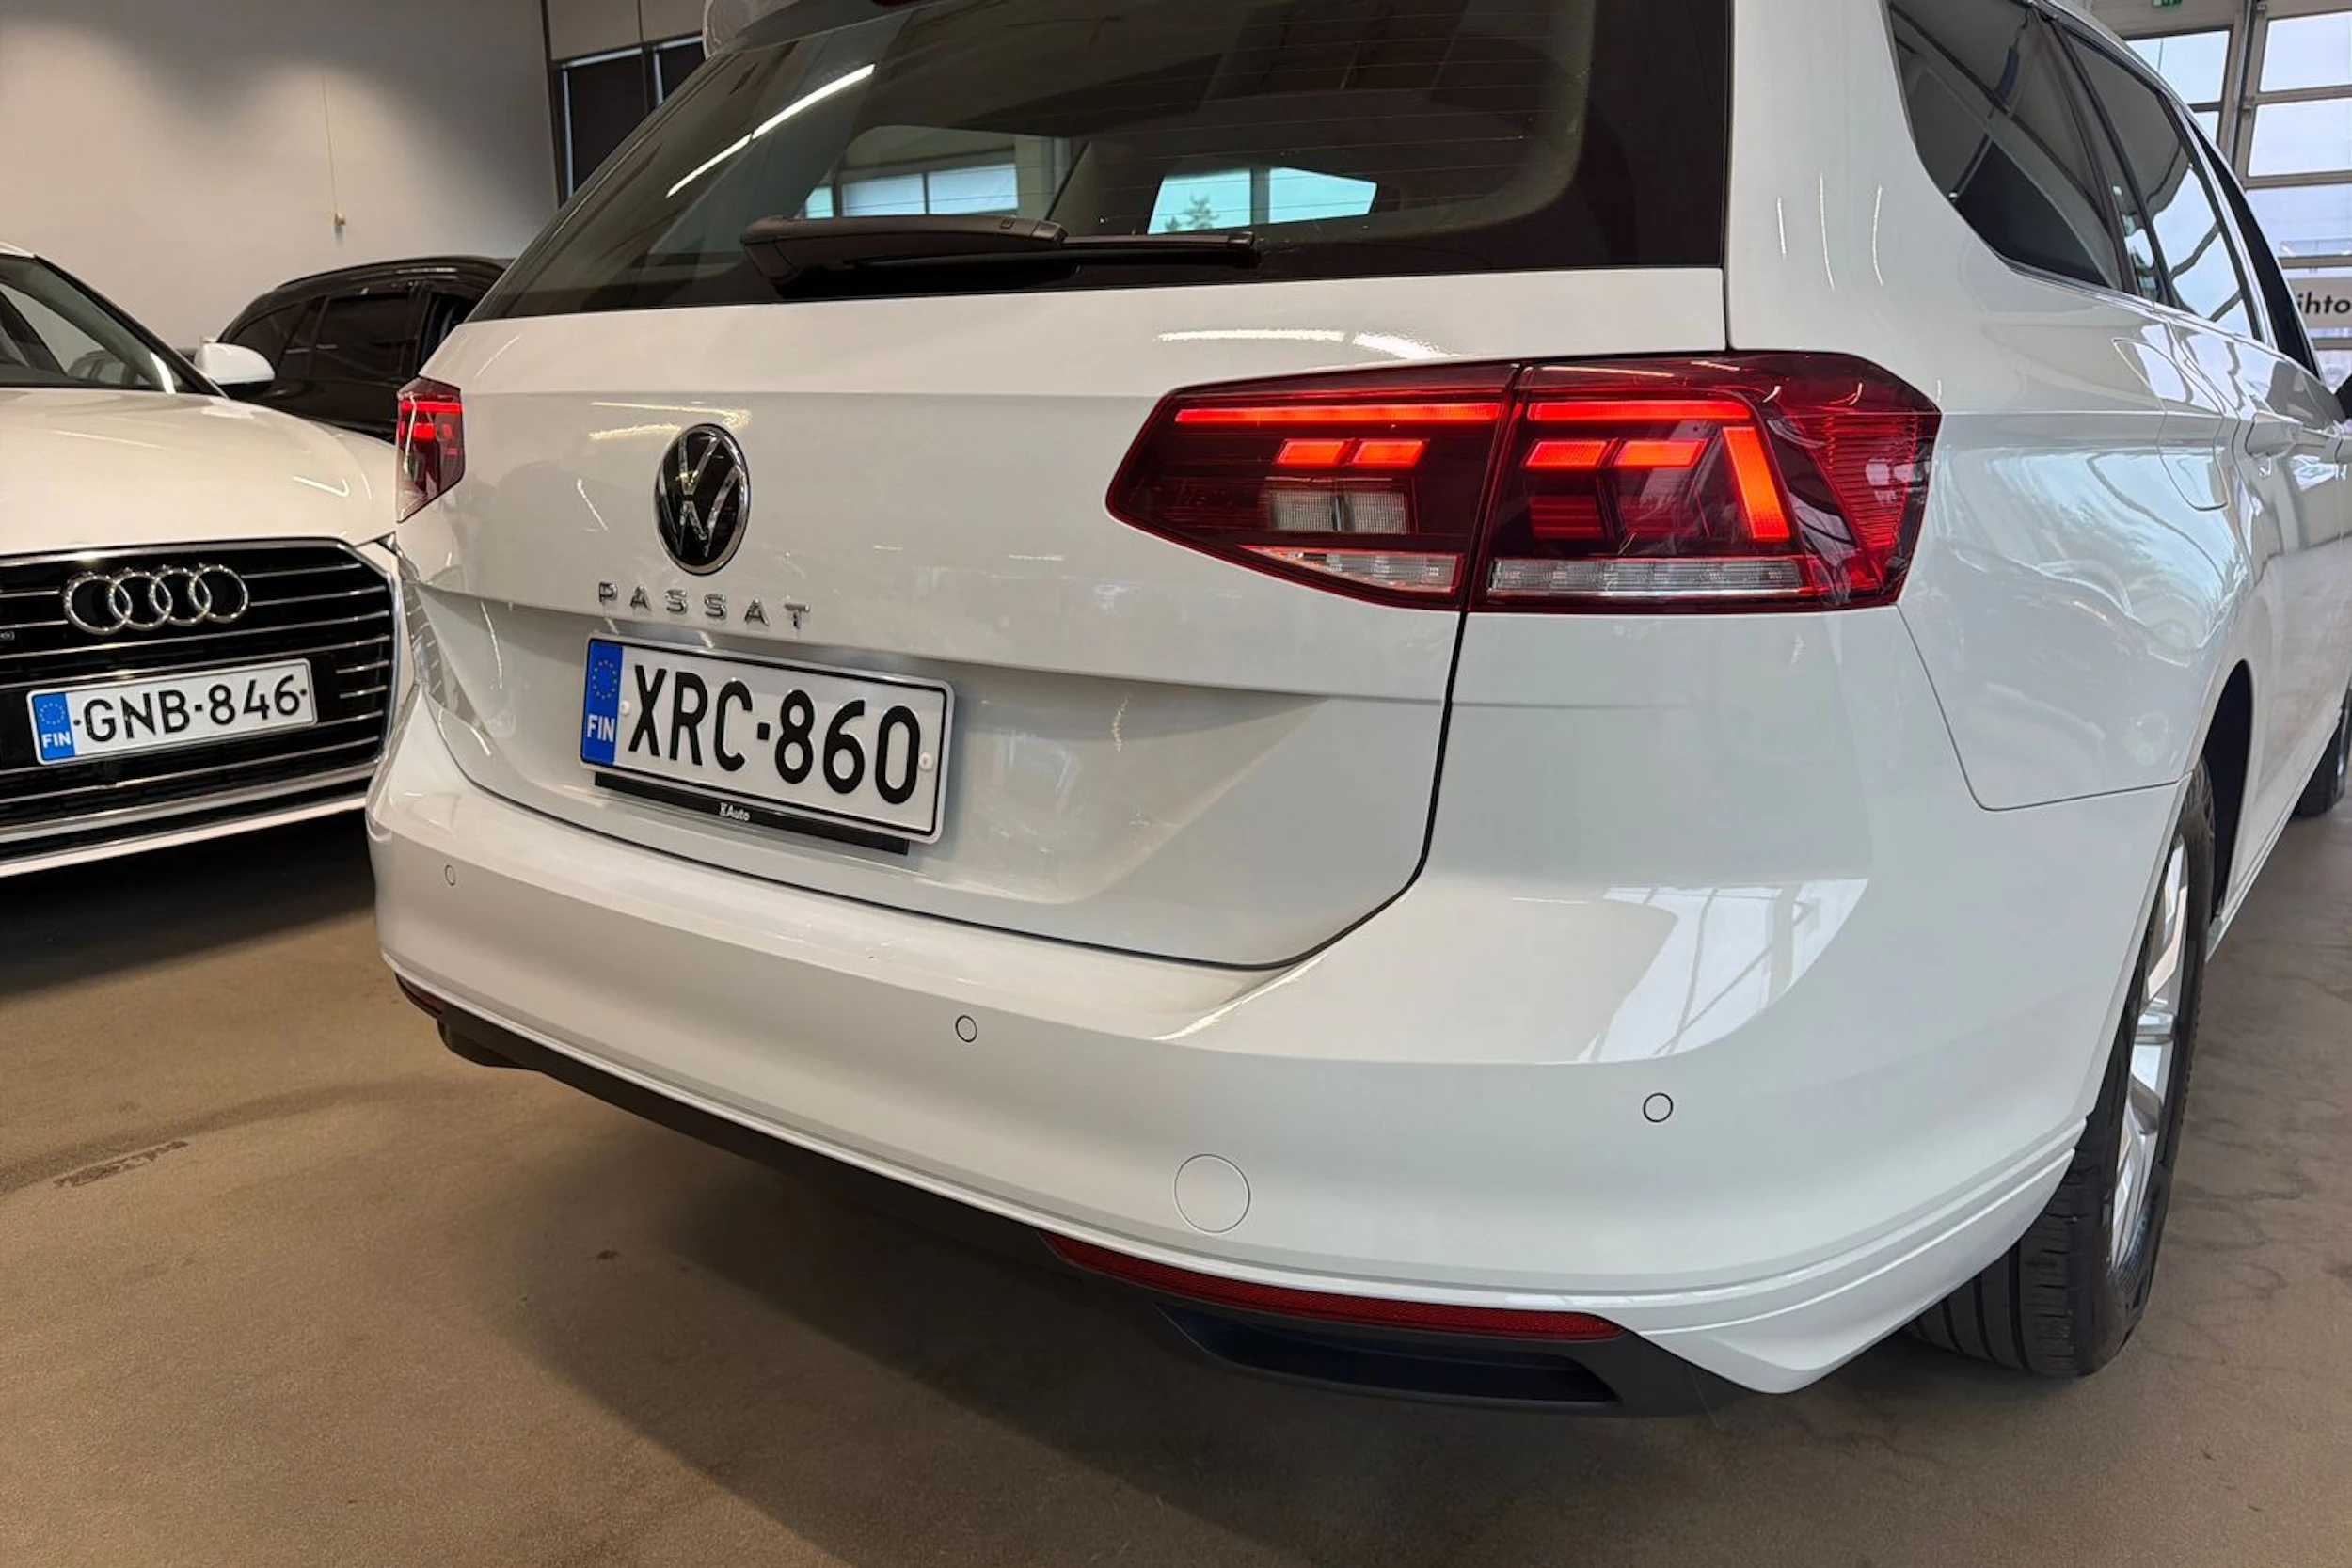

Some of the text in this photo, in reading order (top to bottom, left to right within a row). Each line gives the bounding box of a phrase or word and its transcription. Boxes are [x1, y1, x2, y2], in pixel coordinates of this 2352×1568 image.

[598, 581, 811, 629] PASSAT
[83, 673, 301, 742] GNB-846
[586, 713, 615, 743] FIN
[41, 730, 72, 749] FIN
[628, 664, 921, 805] XRC-860
